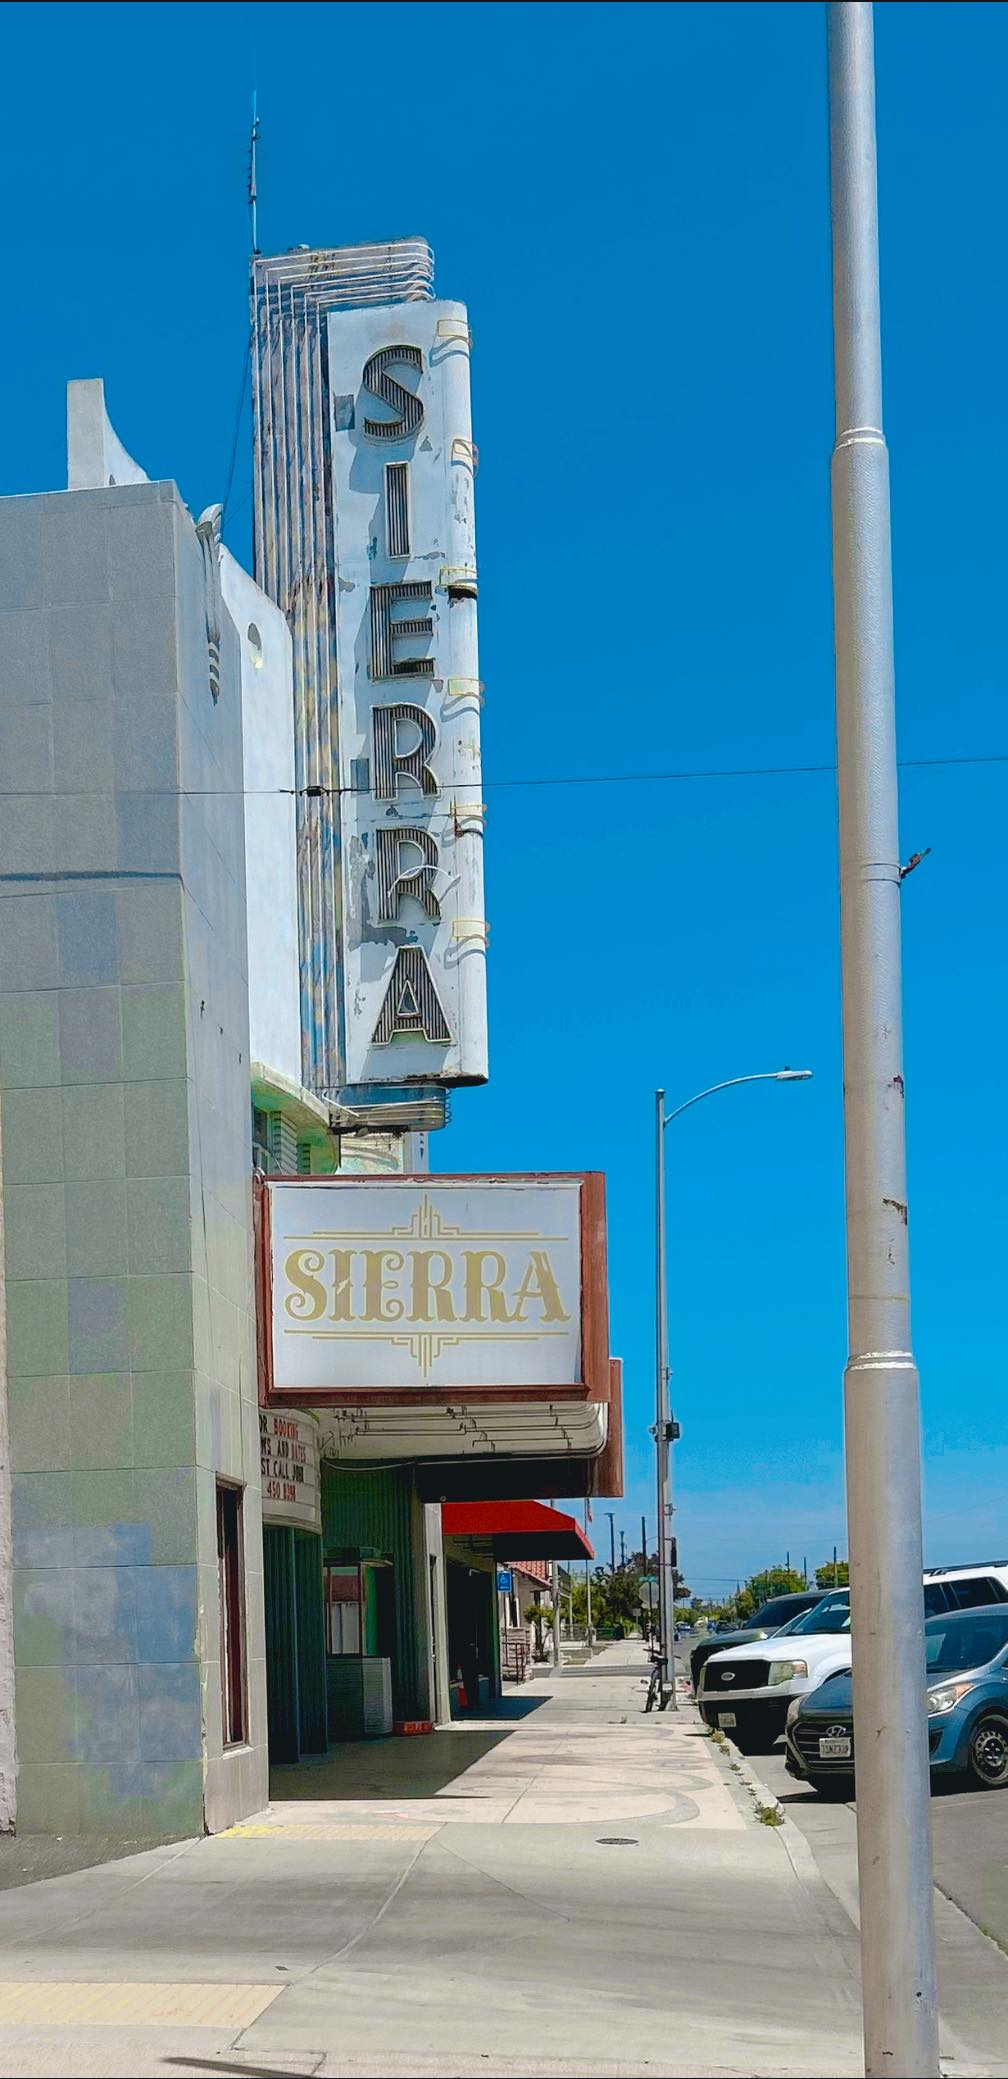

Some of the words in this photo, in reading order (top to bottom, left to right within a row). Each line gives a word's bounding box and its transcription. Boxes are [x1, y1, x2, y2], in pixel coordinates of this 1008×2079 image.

[362, 344, 453, 1046] SIERRA
[283, 1248, 572, 1323] SIERRA
[274, 1462, 289, 1480] CALL
